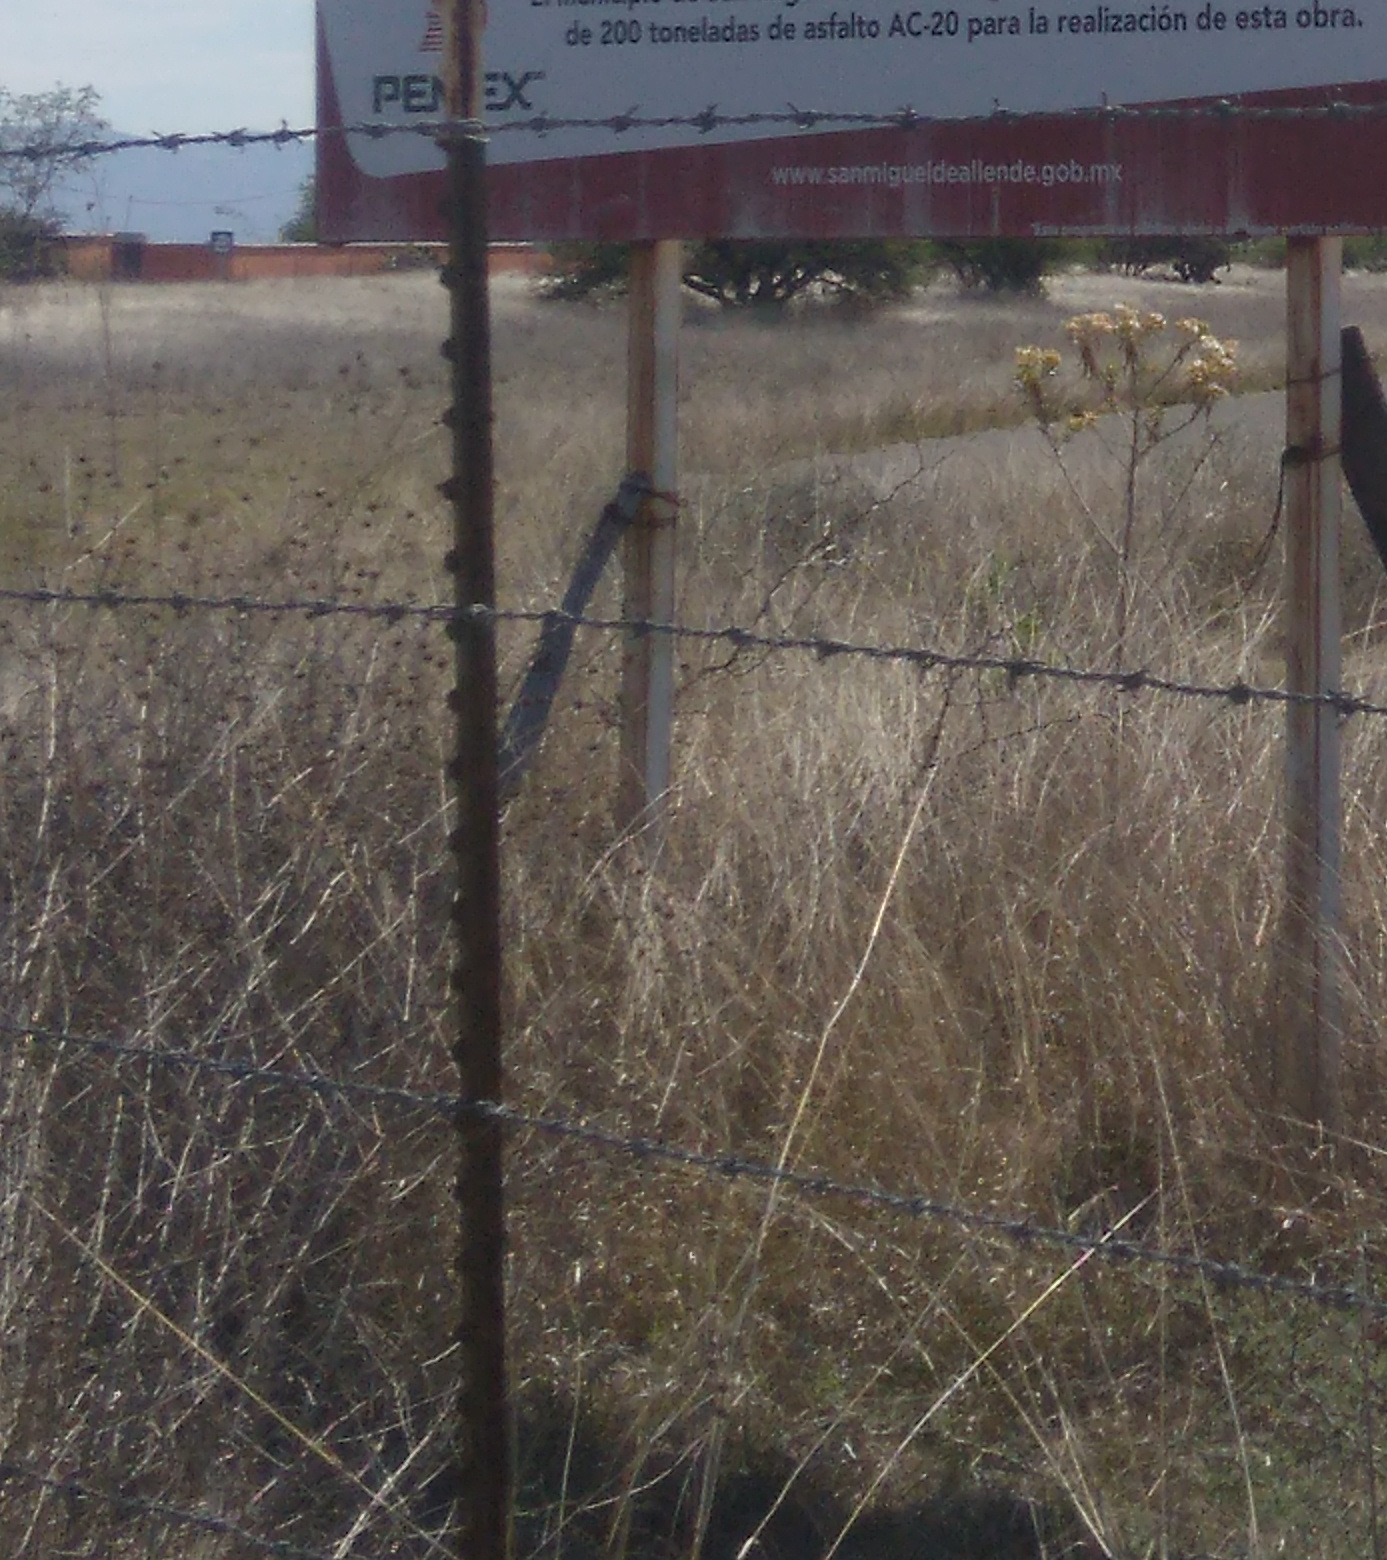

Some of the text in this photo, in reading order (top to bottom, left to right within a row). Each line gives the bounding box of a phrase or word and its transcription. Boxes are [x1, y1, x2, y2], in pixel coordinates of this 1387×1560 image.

[565, 0, 1363, 46] de 200 toneladas de asfalto AC-20 para la realización de esta obra.
[772, 159, 1122, 188] www.sanmigueldeallende.gob.mx
